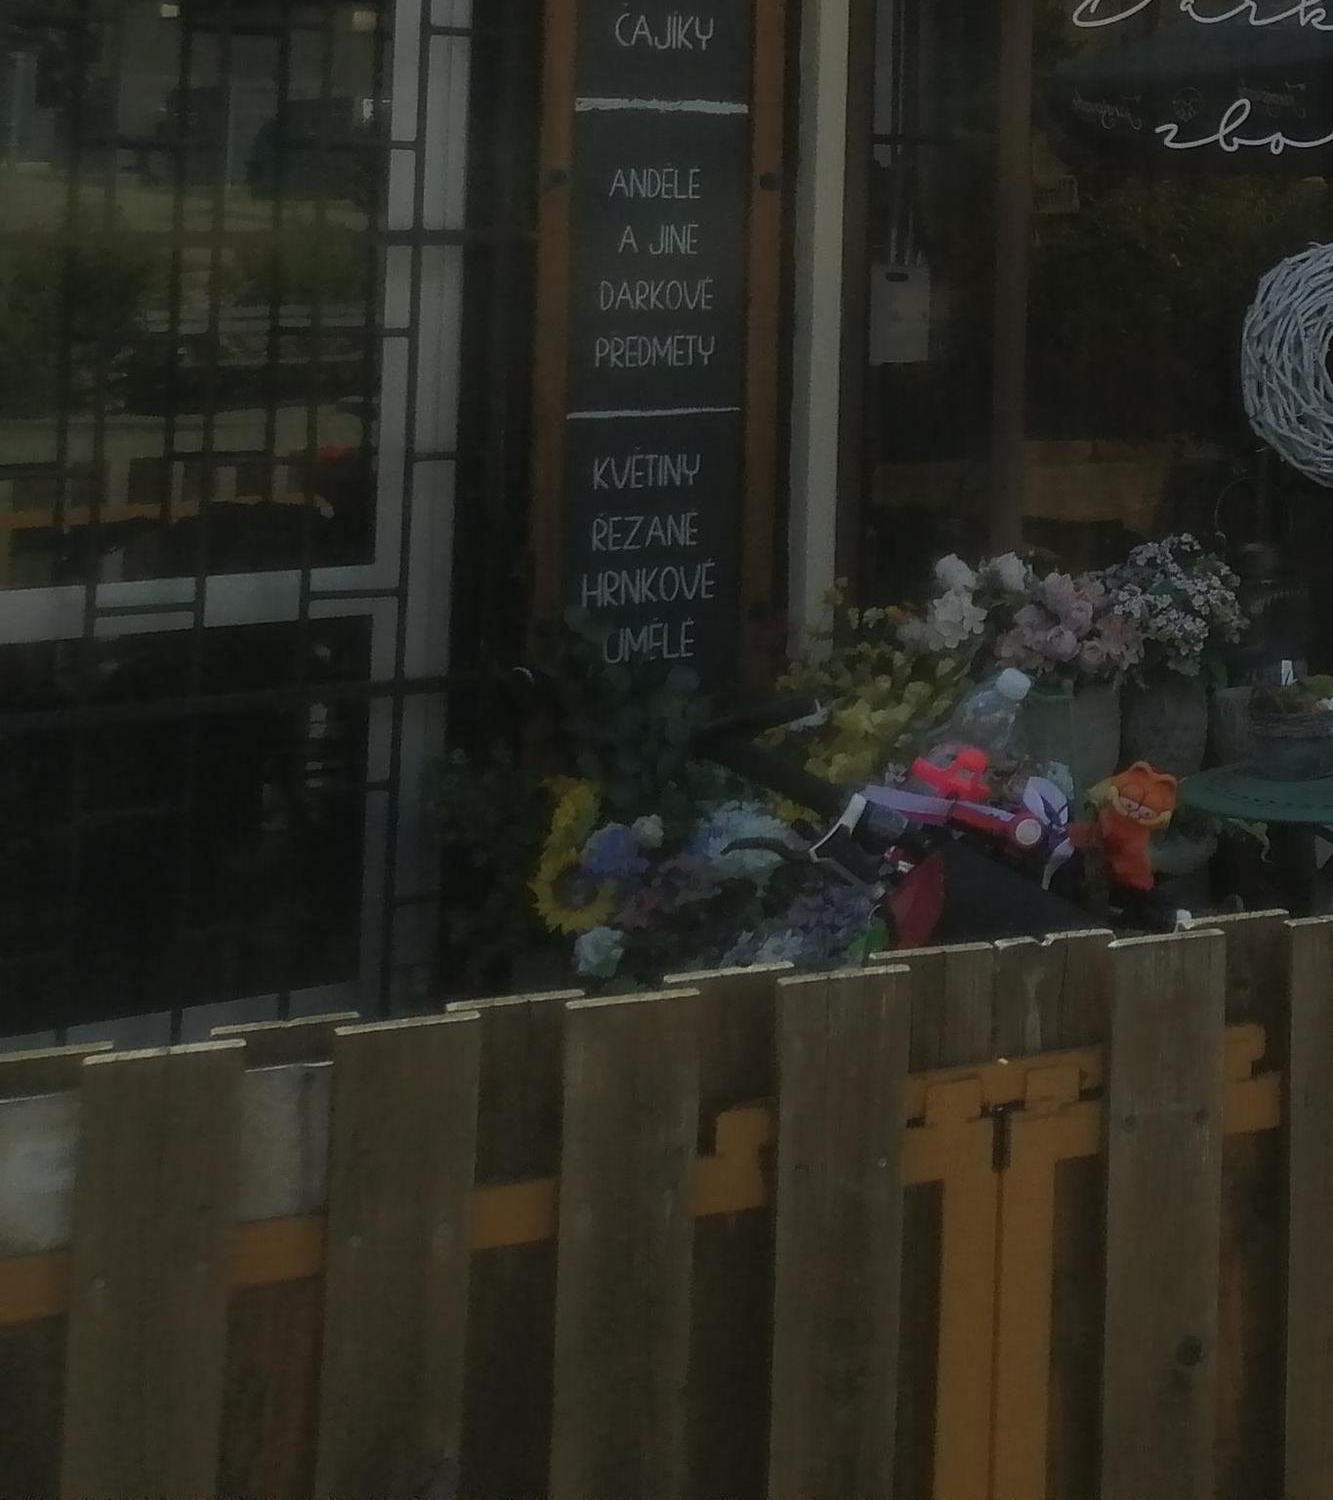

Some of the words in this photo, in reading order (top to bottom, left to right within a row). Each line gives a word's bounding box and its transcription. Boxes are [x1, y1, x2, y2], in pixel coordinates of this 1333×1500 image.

[617, 224, 639, 254] A
[649, 220, 699, 255] JINÉ
[593, 446, 701, 490] KVĚTINY
[581, 558, 716, 608] HRNKOVÉ
